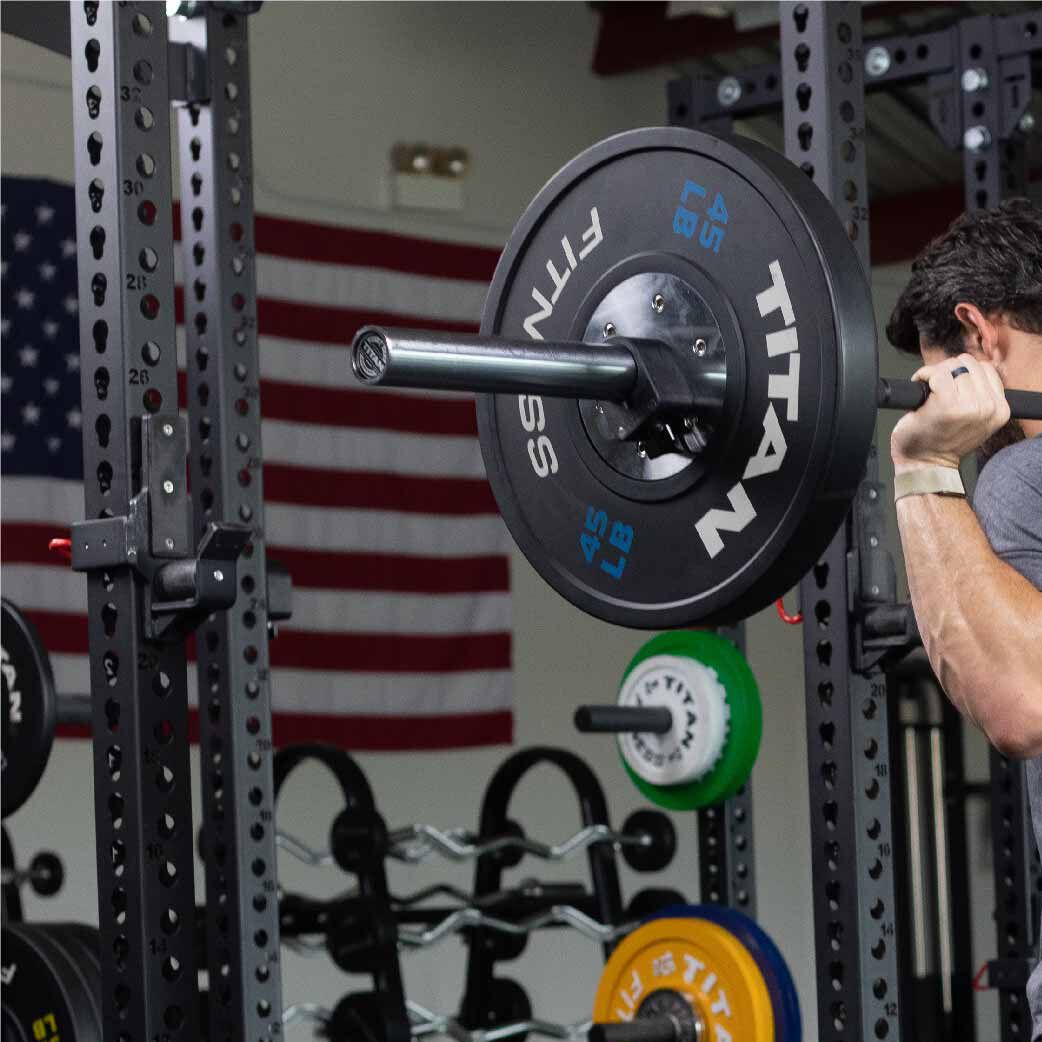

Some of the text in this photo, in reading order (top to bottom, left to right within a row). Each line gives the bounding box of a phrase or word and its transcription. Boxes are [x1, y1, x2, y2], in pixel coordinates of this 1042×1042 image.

[673, 179, 707, 240] LB
[699, 191, 730, 254] 45
[518, 206, 604, 479] FITNSS
[694, 259, 801, 560] TITAN
[578, 504, 608, 566] 45
[600, 518, 635, 580] LB
[663, 674, 697, 750] TITAN
